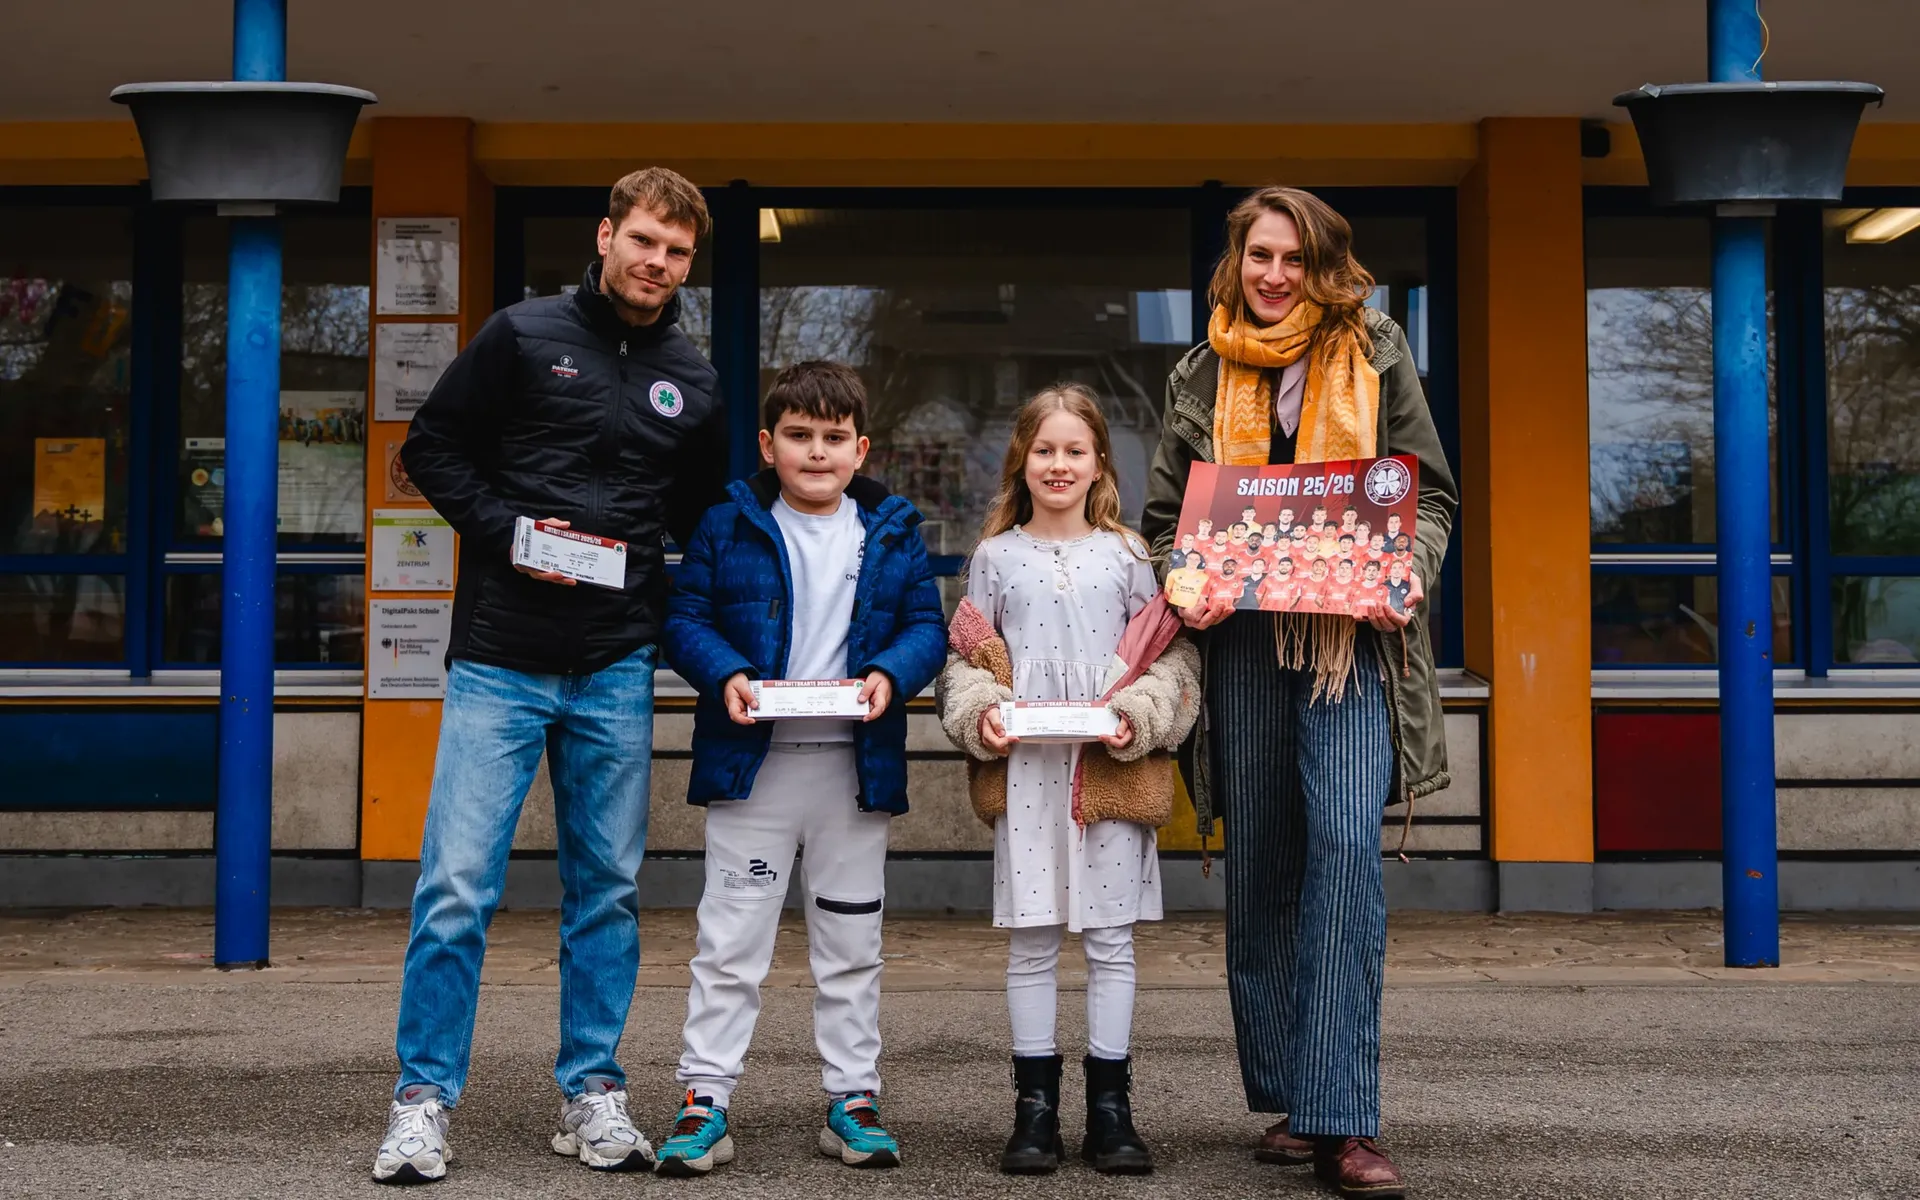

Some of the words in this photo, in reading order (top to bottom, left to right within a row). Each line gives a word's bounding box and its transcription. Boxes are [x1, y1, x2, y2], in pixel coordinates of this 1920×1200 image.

[552, 364, 579, 374] PATRICK
[1237, 477, 1300, 496] SAISON
[1302, 473, 1355, 497] 25/26
